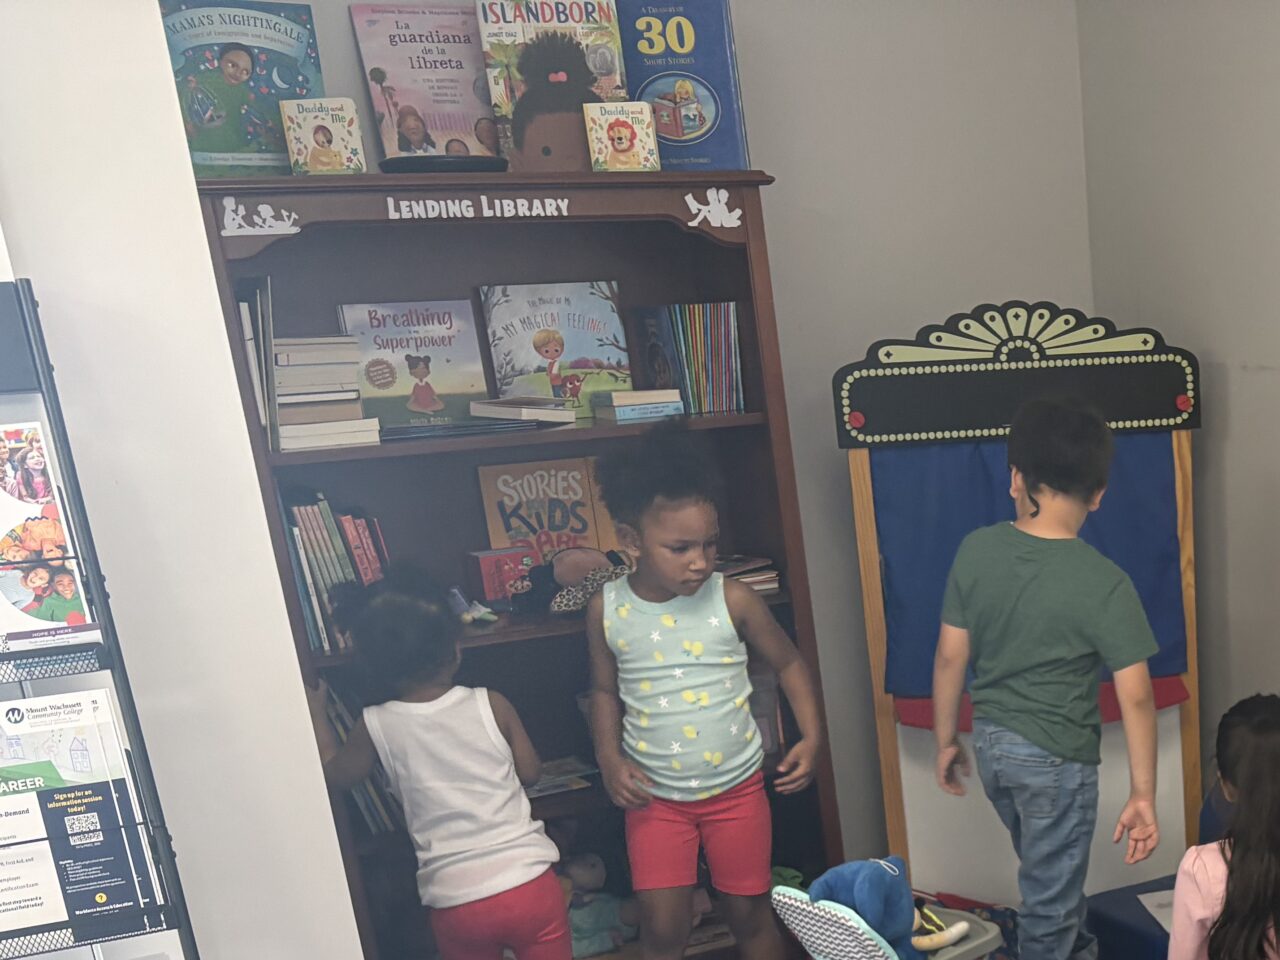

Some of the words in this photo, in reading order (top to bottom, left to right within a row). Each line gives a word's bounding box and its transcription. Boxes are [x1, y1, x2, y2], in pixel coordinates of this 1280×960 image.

[482, 1, 613, 24] ISLANDBORN
[166, 13, 214, 35] MAMA'S
[218, 12, 304, 44] NIGHTINGALE
[395, 20, 410, 30] La
[389, 30, 472, 46] guardiana
[635, 16, 696, 55] 30
[421, 46, 433, 55] de
[436, 46, 446, 55] la
[408, 56, 464, 70] libreta
[297, 103, 329, 115] Daddy
[600, 106, 630, 118] Daddy
[331, 114, 346, 123] Me
[631, 116, 645, 125] Me
[386, 197, 475, 219] LENDING
[480, 195, 569, 218] LIBRARY
[368, 308, 453, 330] Breathing
[501, 321, 518, 338] MY
[373, 334, 455, 353] Superpower
[26, 705, 47, 713] Mount
[0, 777, 45, 793] AREER
